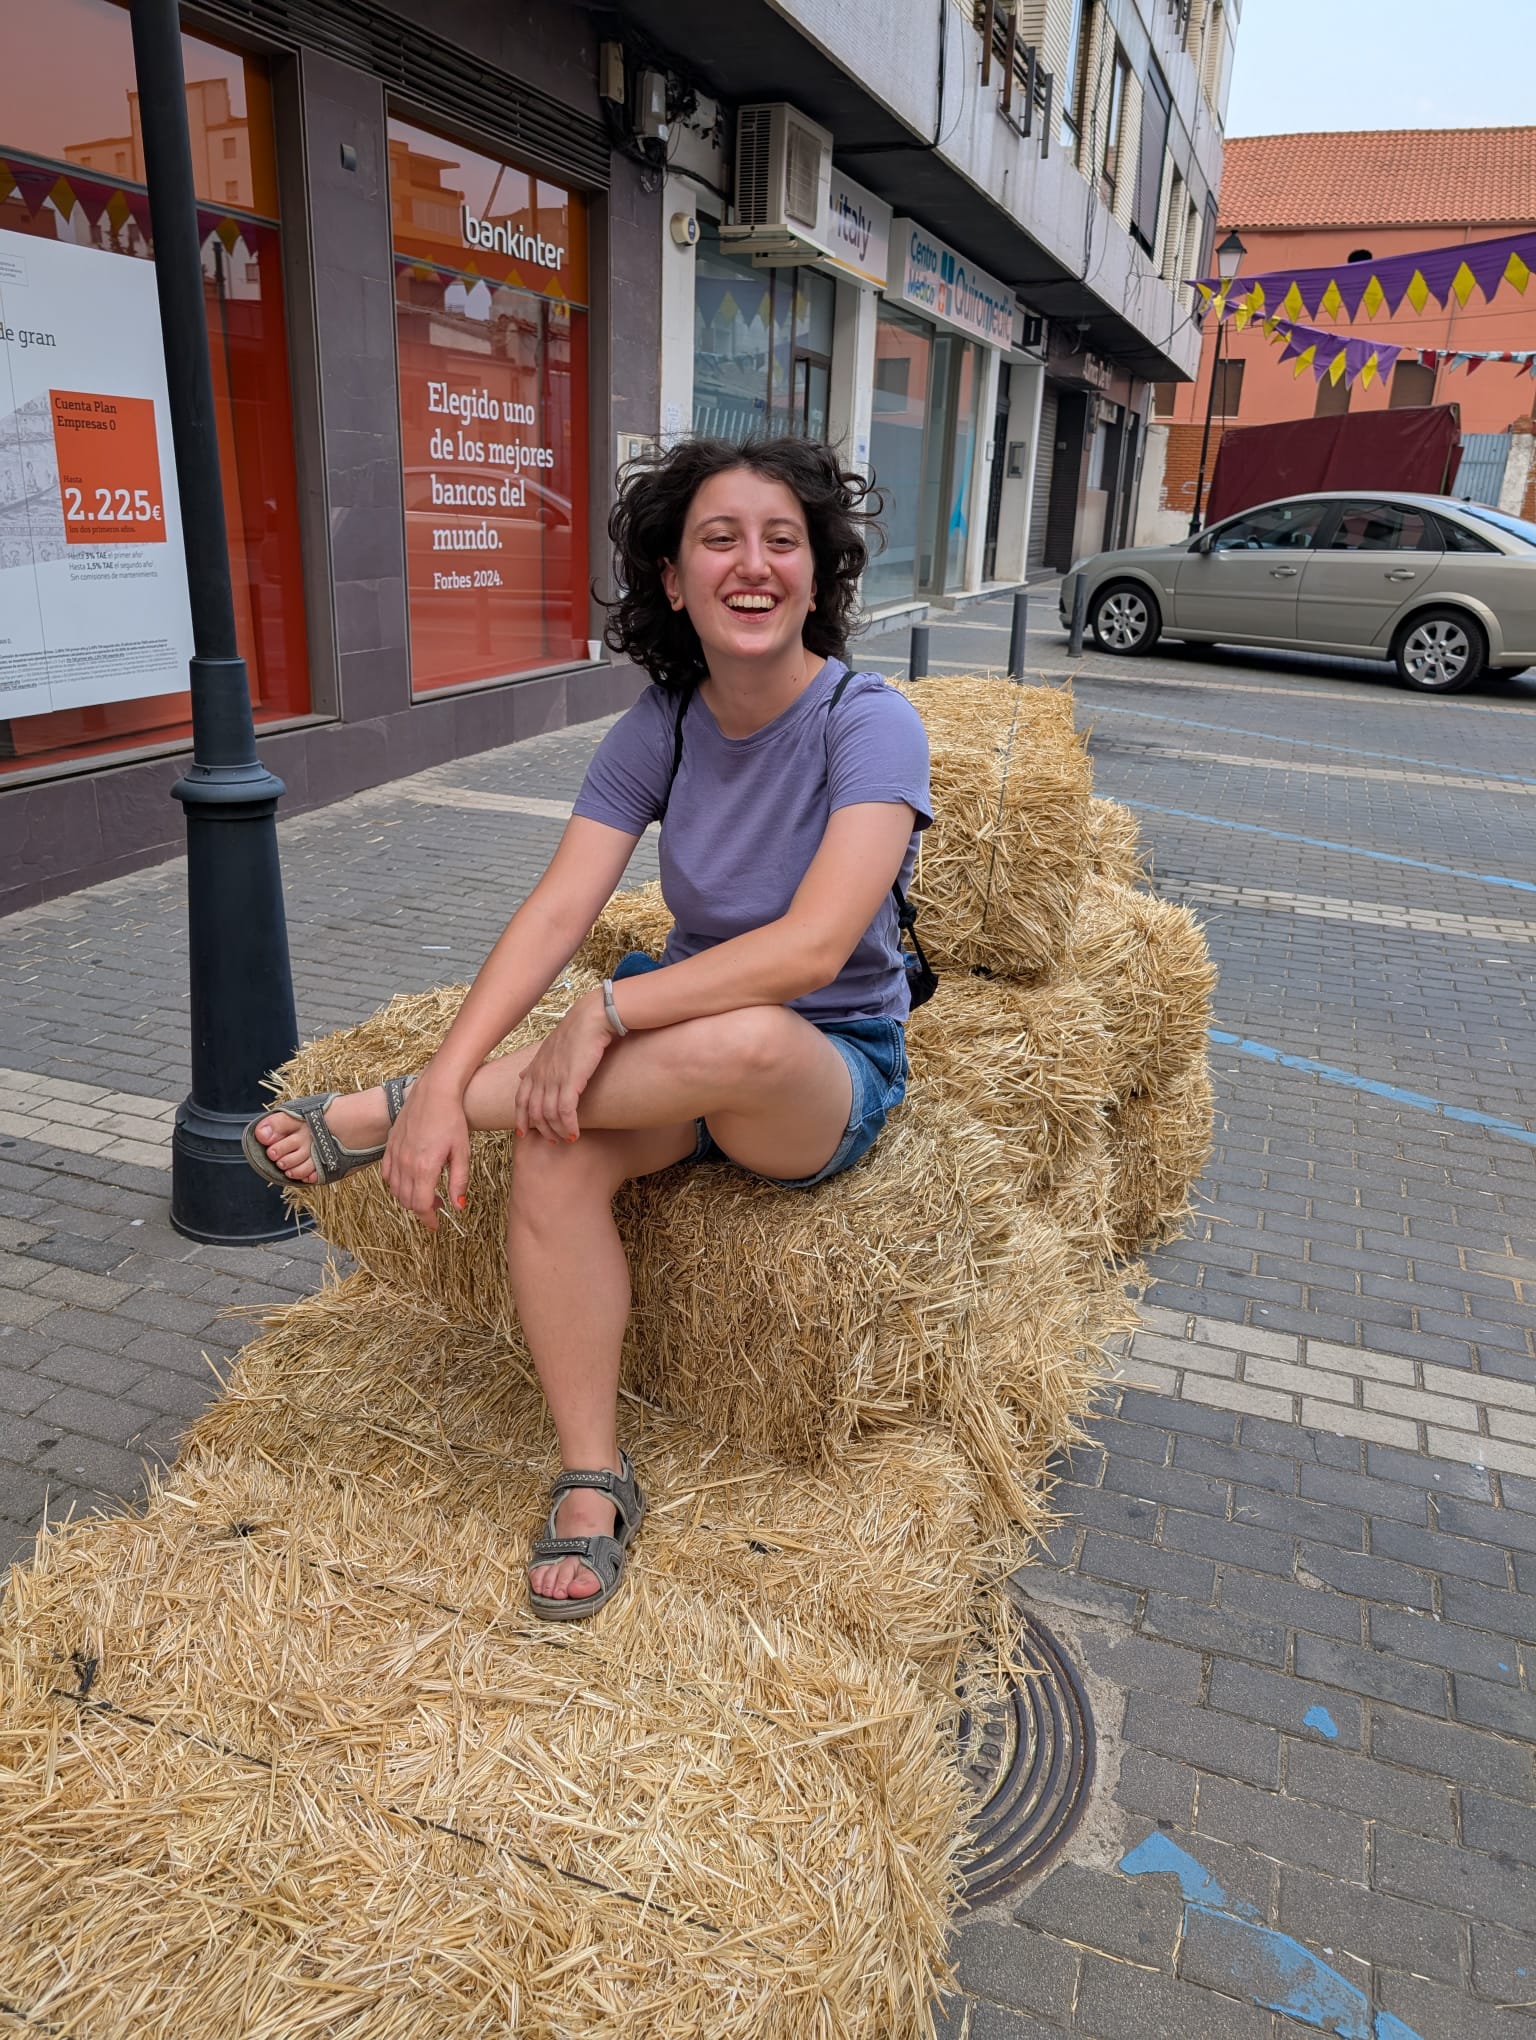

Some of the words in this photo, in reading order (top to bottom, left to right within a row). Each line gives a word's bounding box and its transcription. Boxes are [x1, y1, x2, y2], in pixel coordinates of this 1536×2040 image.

[462, 204, 565, 271] bankinter
[910, 231, 937, 273] Centro
[954, 267, 1012, 341] Quiromedic
[19, 330, 56, 348] gran
[54, 397, 92, 412] Cuenta
[94, 401, 117, 414] Plan
[427, 381, 500, 425] Elegido
[502, 400, 535, 425] uno
[57, 415, 107, 431] Empresas
[430, 427, 454, 460] de
[457, 430, 485, 462] los
[488, 438, 554, 474] mejores
[65, 487, 162, 521] 2.225€
[430, 473, 497, 506] bancos
[500, 478, 526, 507] del
[432, 521, 503, 551] mundo.
[96, 551, 107, 559] TAE
[103, 561, 114, 569] TAE
[433, 571, 471, 590] Forbes
[473, 569, 503, 588] 2024.
